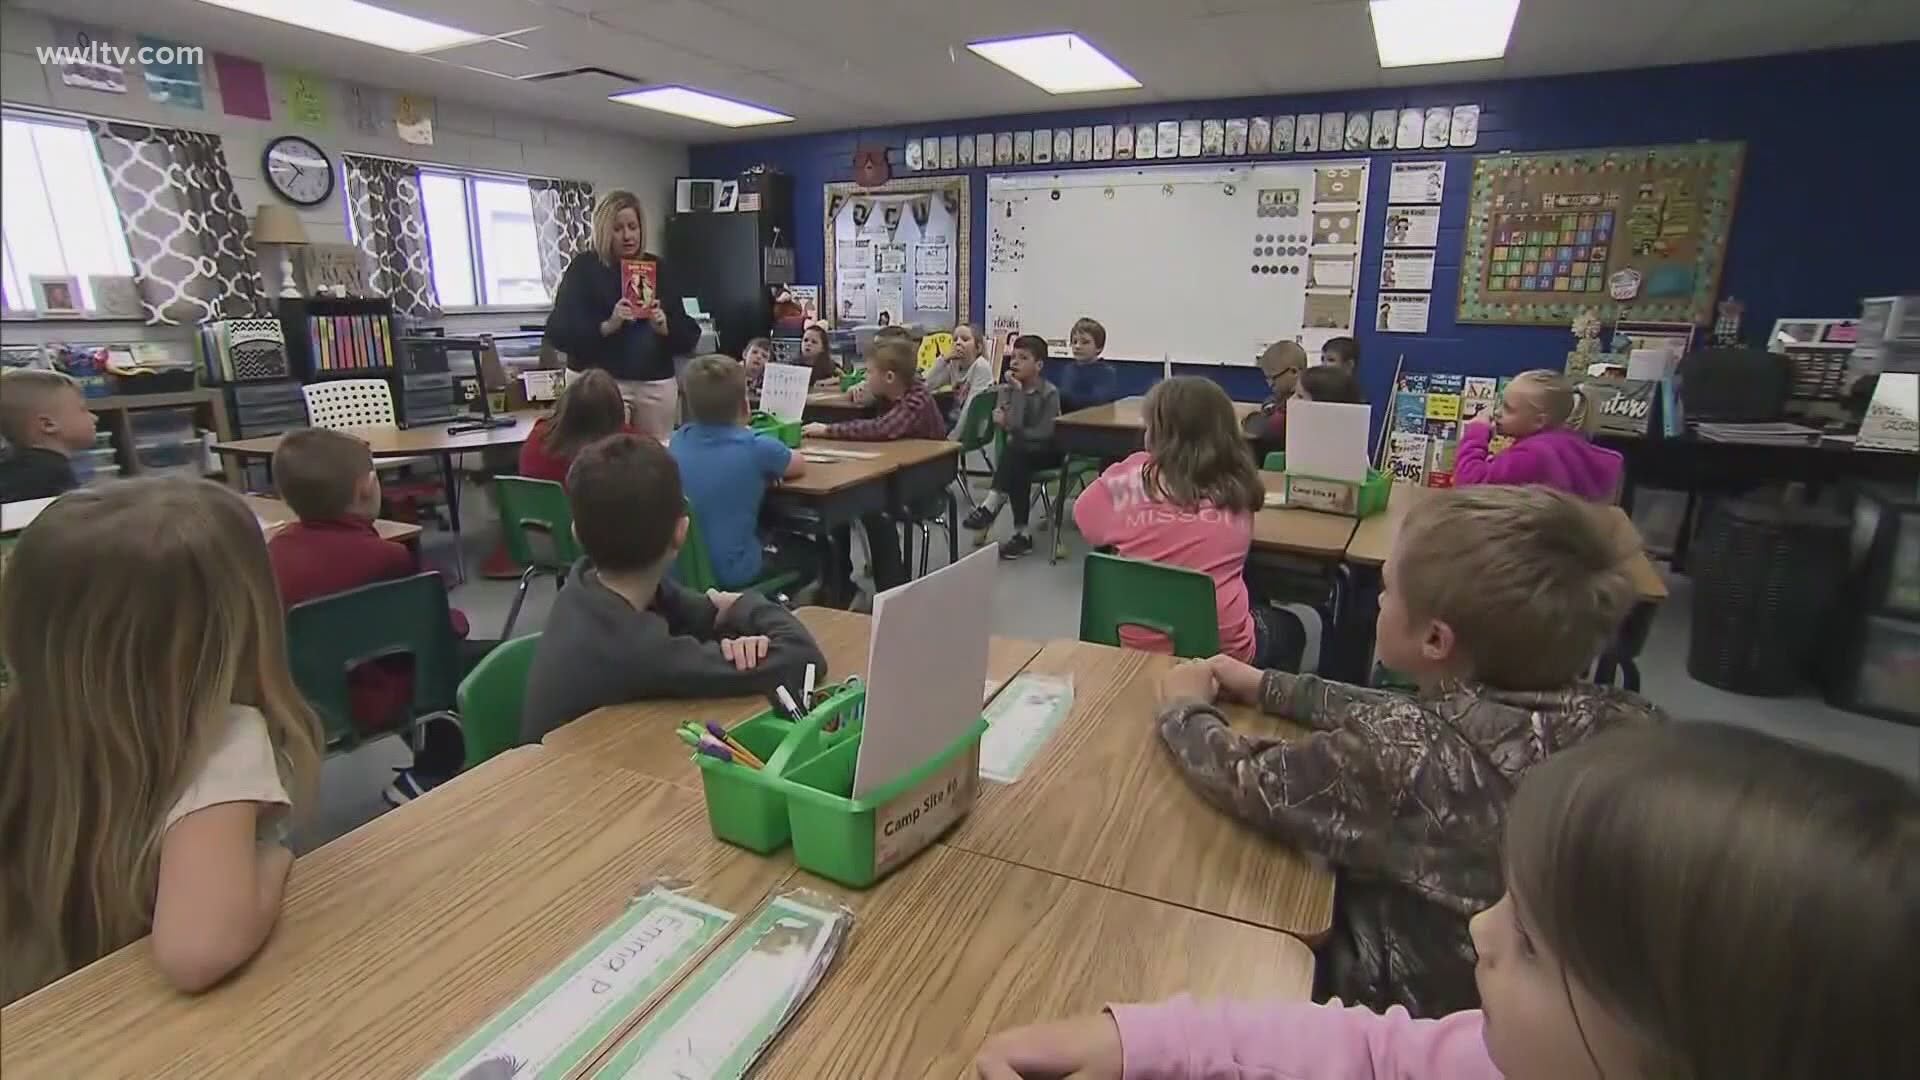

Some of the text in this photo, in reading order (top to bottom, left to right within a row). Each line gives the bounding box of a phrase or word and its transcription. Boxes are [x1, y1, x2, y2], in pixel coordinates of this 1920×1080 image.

[884, 807, 920, 837] Camp
[923, 790, 944, 813] Site
[608, 914, 684, 973] Emma
